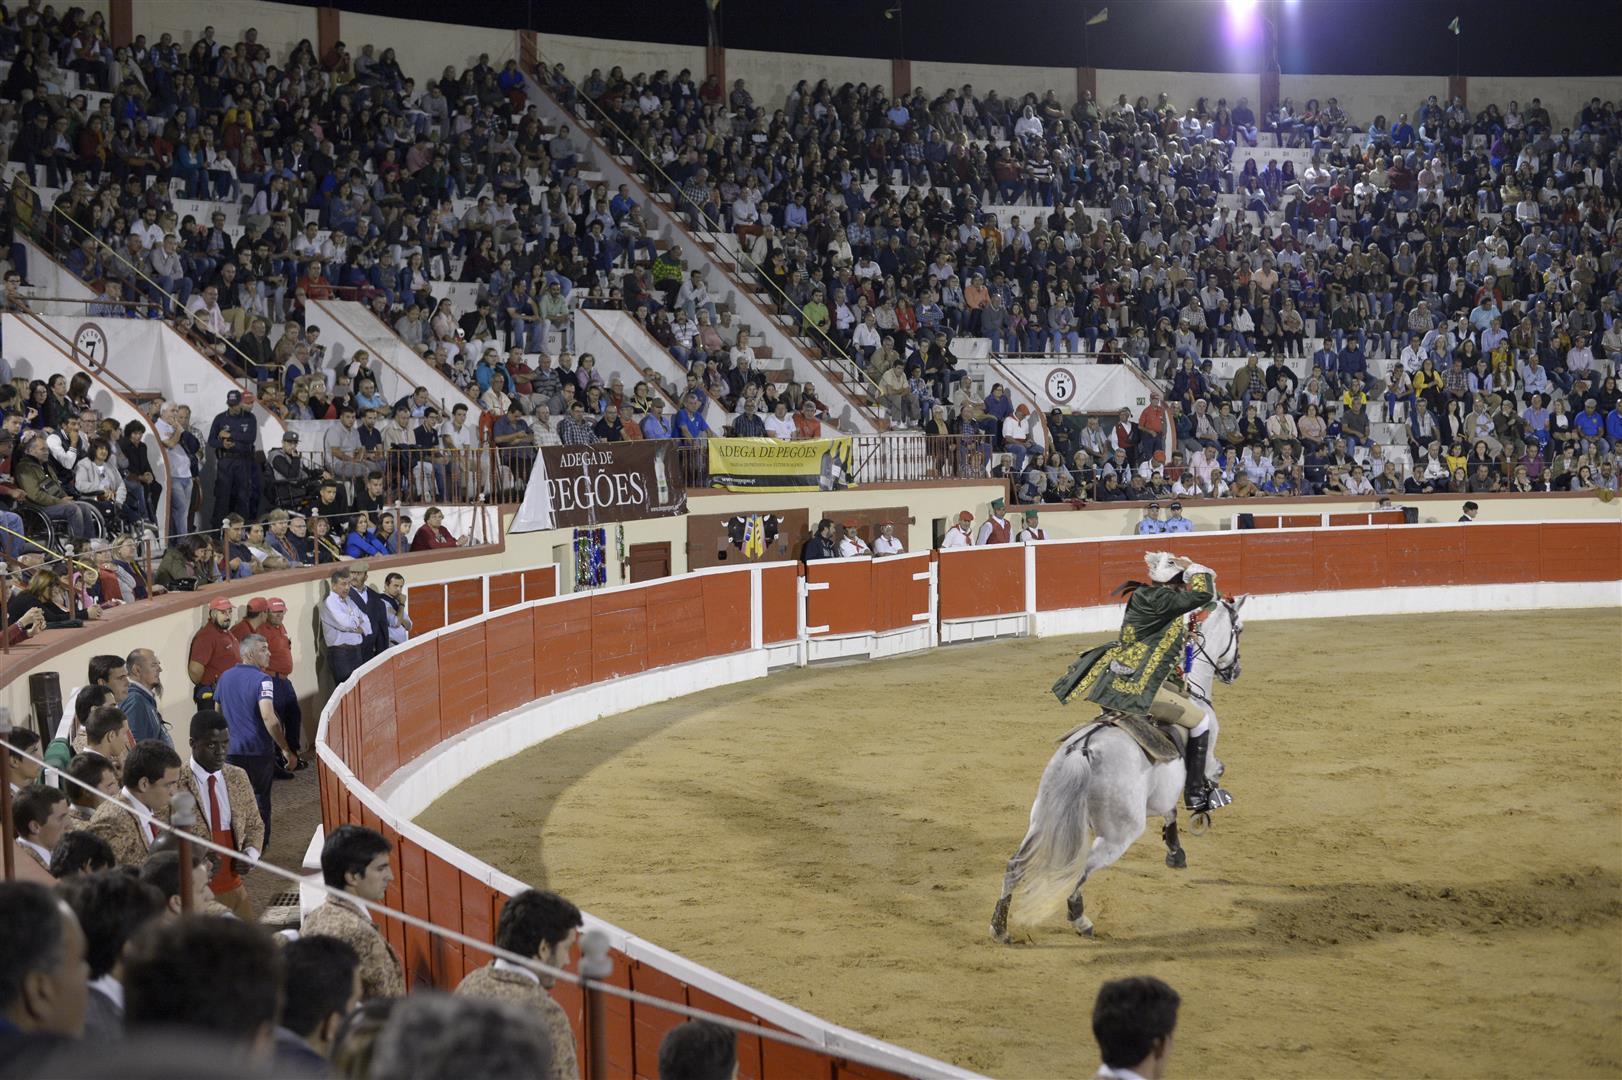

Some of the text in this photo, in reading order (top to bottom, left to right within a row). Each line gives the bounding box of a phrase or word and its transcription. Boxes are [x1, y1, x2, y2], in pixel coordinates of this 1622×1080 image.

[86, 341, 96, 367] 7
[1056, 380, 1066, 398] 5
[560, 450, 614, 468] ADEGA DE
[720, 445, 756, 458] ADEGA
[758, 446, 775, 458] DE
